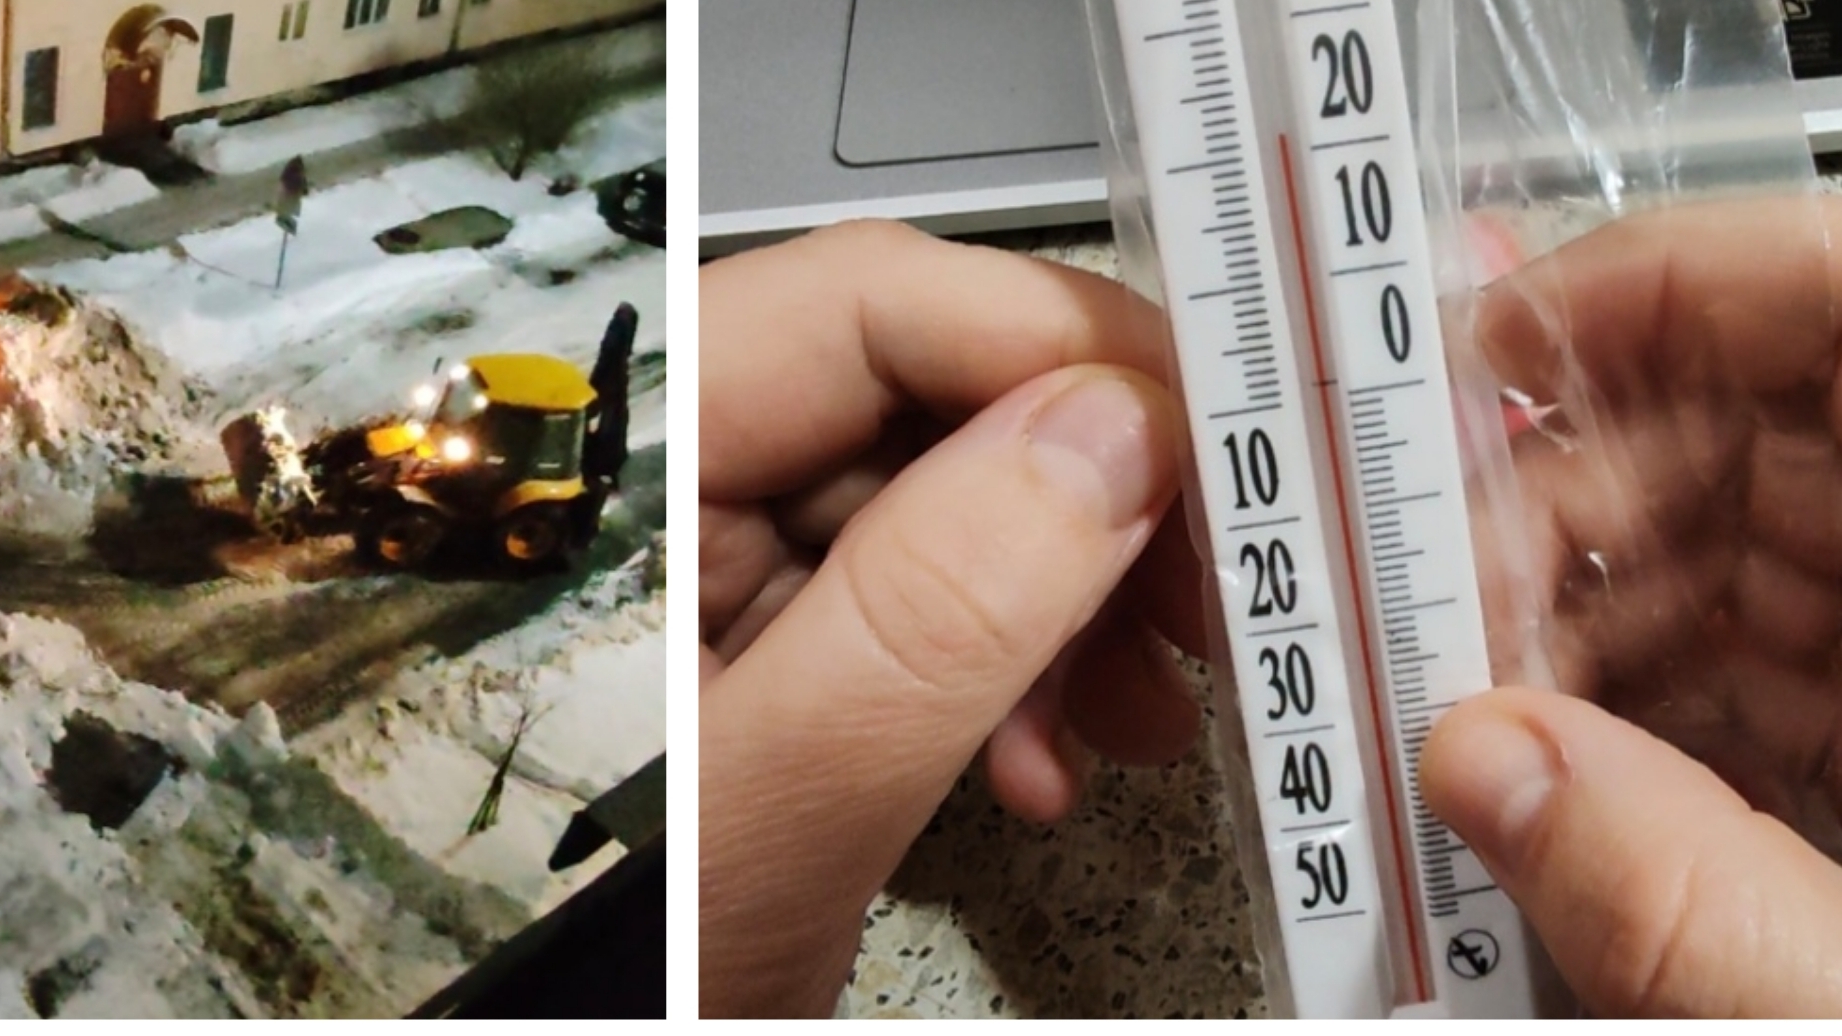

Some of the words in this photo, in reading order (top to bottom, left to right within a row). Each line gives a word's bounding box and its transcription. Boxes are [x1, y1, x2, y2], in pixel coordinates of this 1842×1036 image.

[1311, 29, 1374, 118] 20
[1334, 161, 1393, 247] 10
[1380, 284, 1412, 363] 0
[1223, 428, 1280, 509] 10
[1240, 538, 1298, 618] 20
[1259, 642, 1315, 721] 30
[1280, 742, 1333, 815] 40
[1295, 842, 1349, 909] 50
